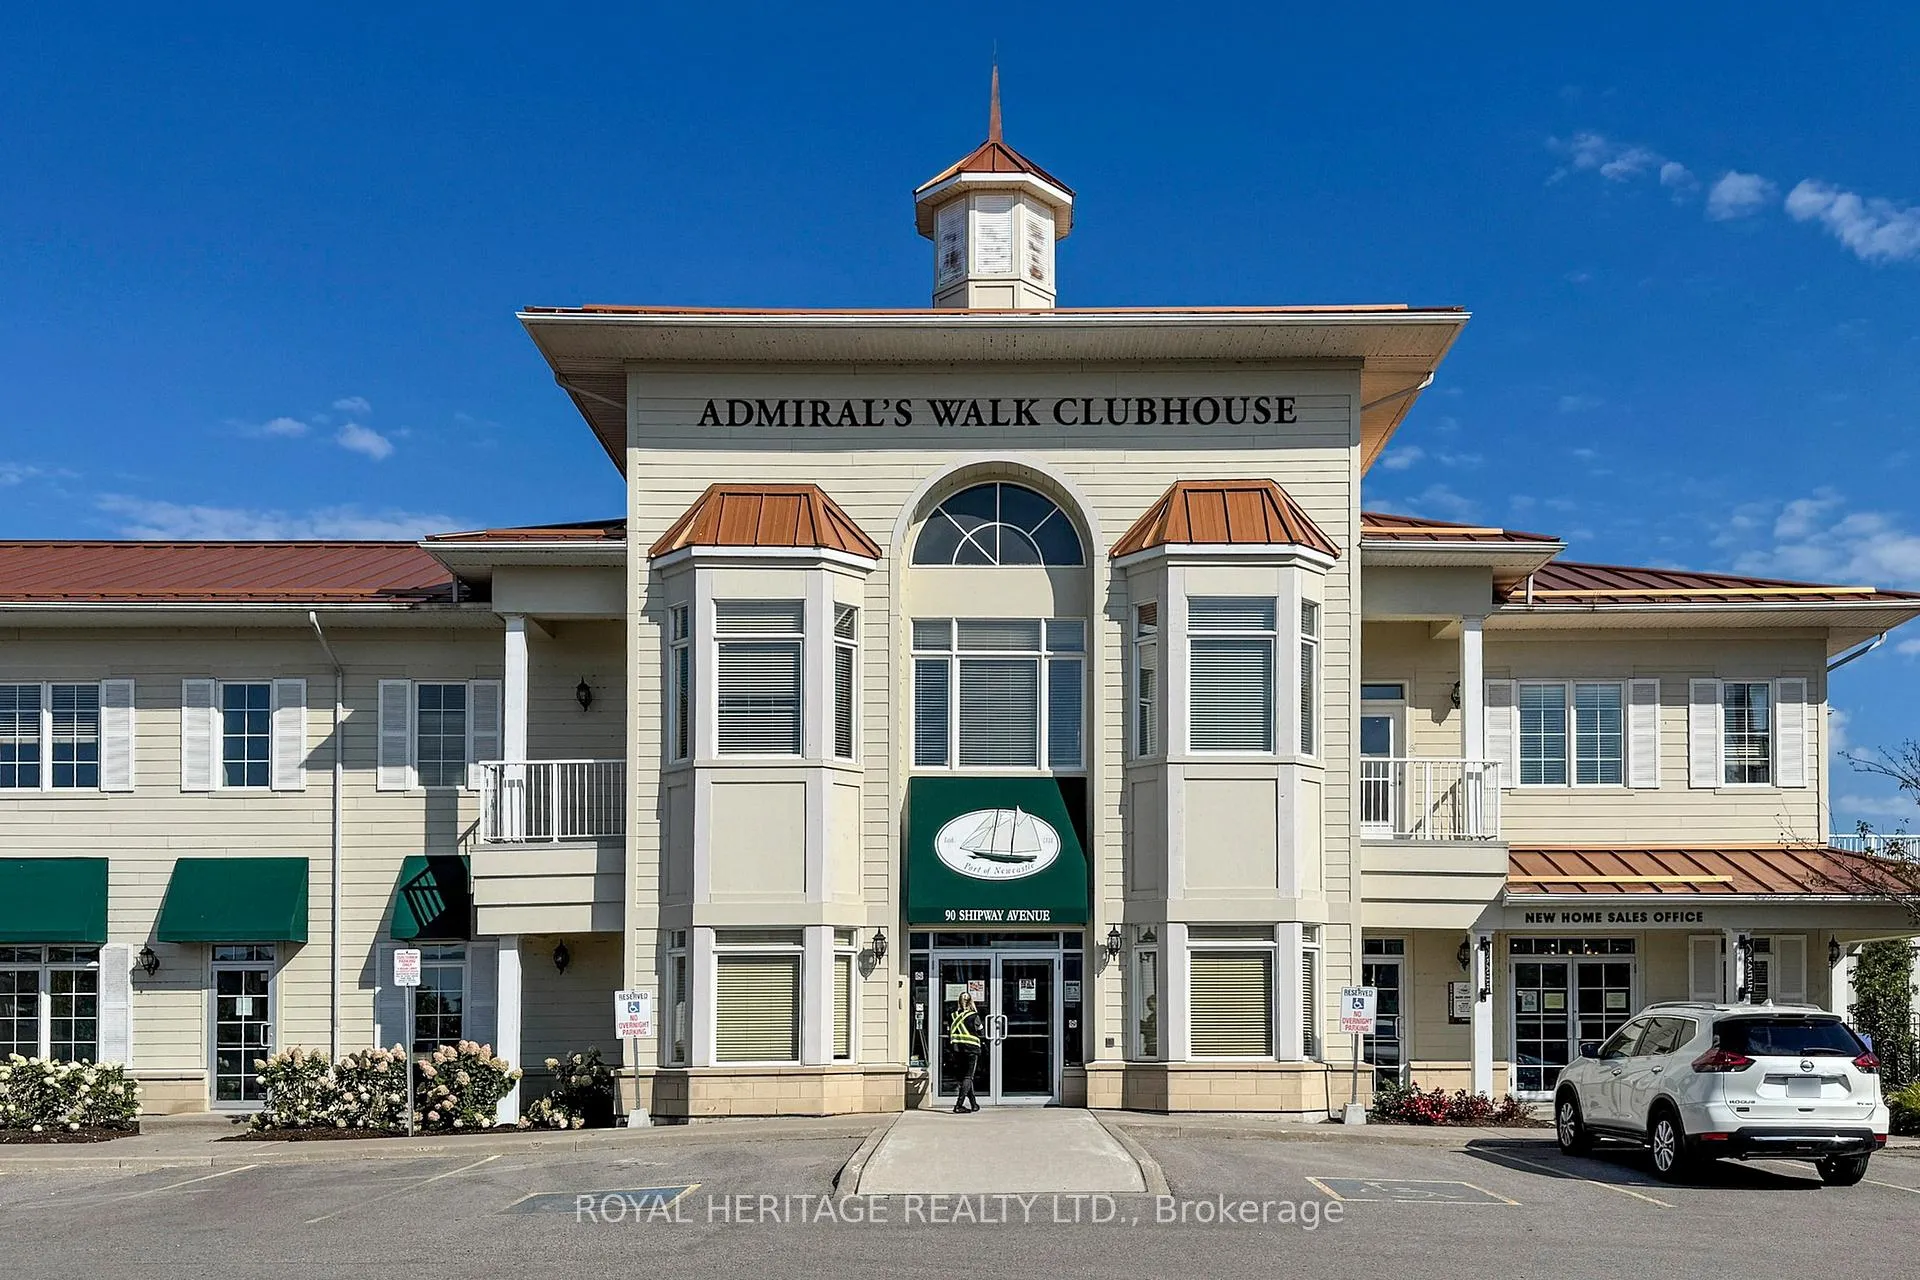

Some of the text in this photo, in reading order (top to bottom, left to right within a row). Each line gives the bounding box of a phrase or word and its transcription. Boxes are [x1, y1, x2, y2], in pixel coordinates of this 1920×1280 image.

[697, 396, 1297, 427] ADMIRAL'S WALK CLUBHOUSE
[963, 862, 980, 873] Port
[983, 866, 991, 875] of
[944, 909, 1050, 921] 90 SHIPWAY AVENUE
[1525, 911, 1703, 923] NEW HOME SALES OFFICE
[619, 993, 648, 1001] RESERVED
[1344, 989, 1373, 997] RESERVED
[619, 1021, 649, 1029] OVERNIGHT
